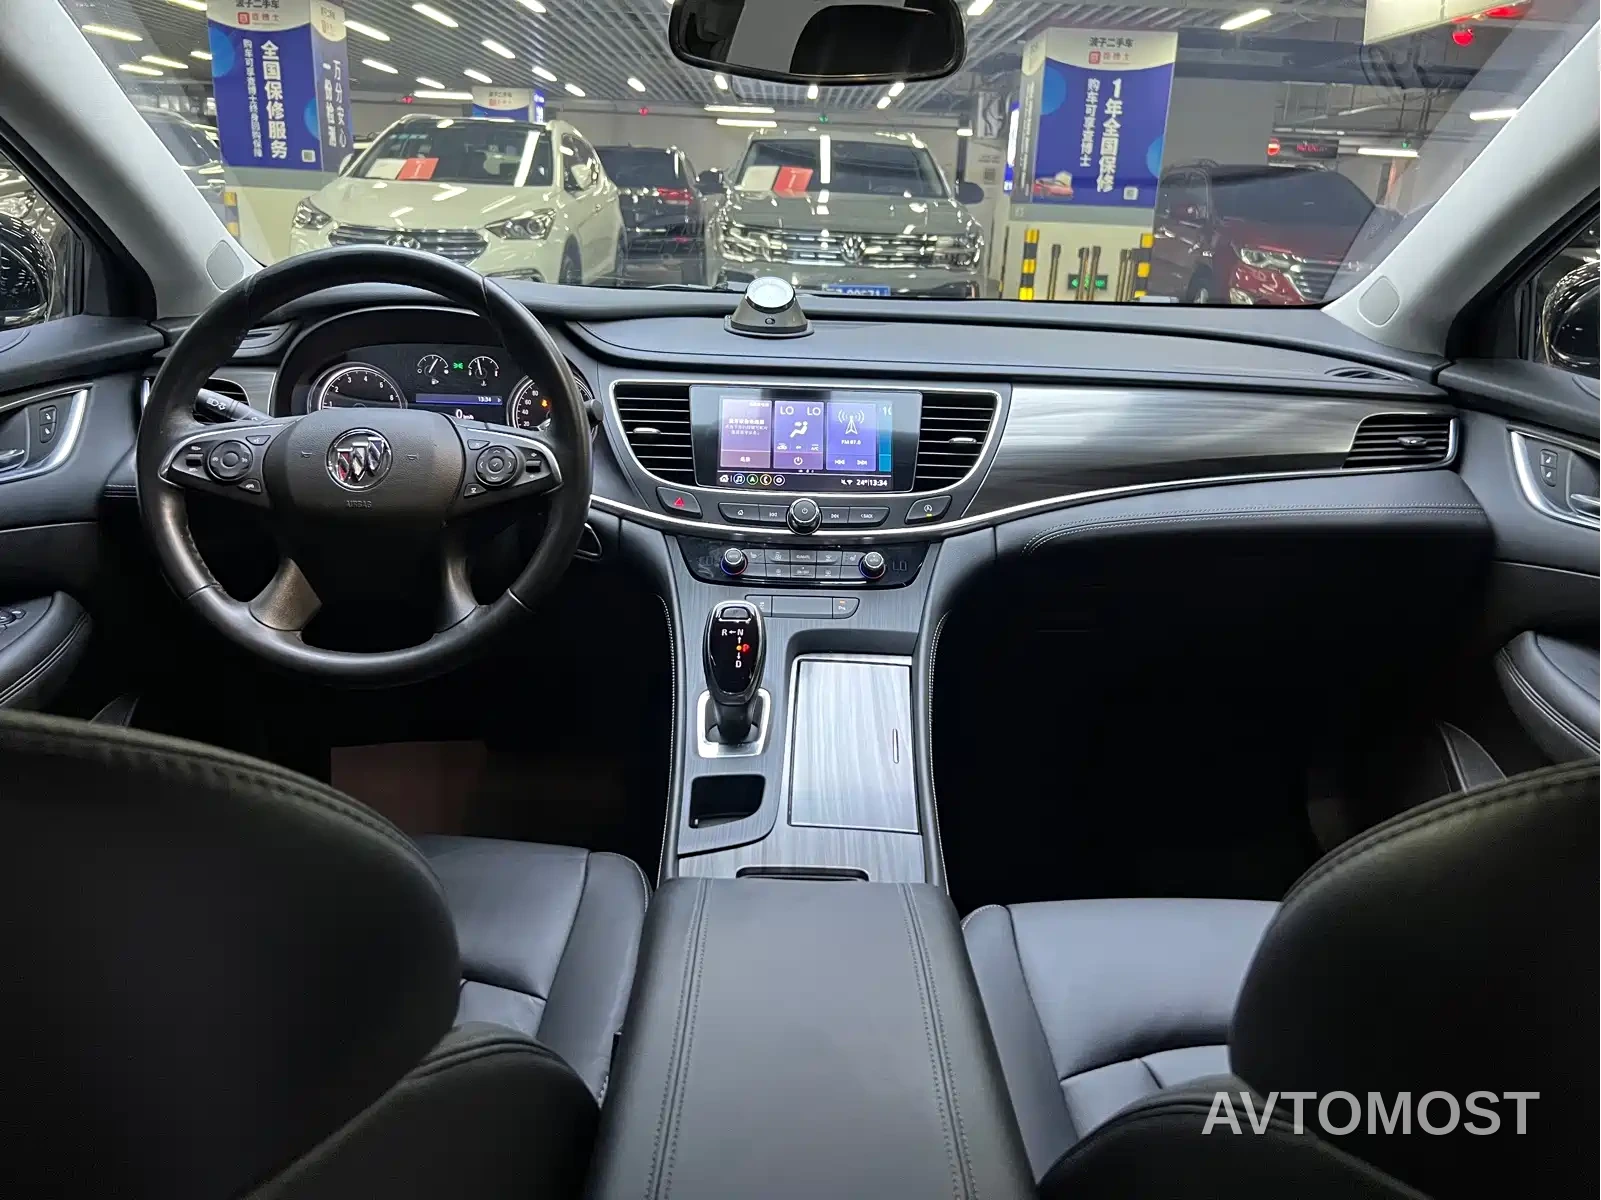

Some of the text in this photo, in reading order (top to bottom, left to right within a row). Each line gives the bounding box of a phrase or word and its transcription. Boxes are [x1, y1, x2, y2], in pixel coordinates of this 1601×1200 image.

[261, 40, 287, 159] 全国保修服务
[333, 60, 347, 148] 万分安心
[1097, 78, 1123, 192] 1年全国保修
[456, 408, 462, 420] 0
[780, 406, 821, 416] LO LO
[722, 628, 744, 636] R N
[742, 644, 750, 652] P
[735, 660, 742, 668] D
